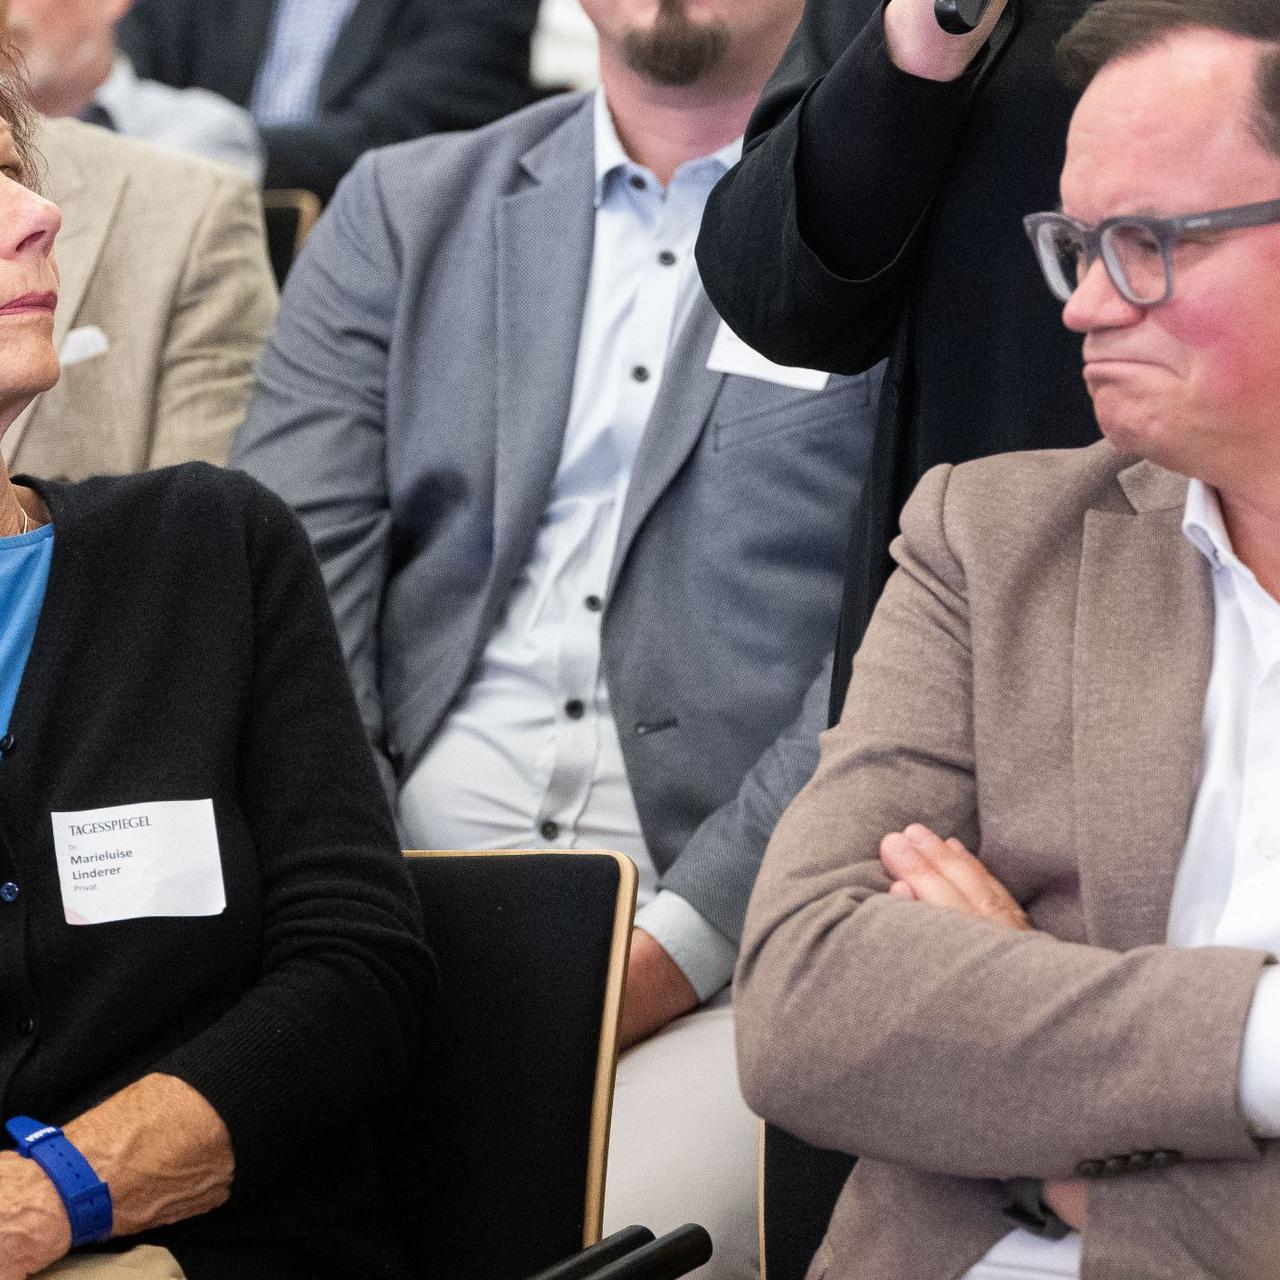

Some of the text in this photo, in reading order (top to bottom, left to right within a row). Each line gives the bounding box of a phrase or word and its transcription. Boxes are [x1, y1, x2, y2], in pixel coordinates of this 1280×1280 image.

[68, 815, 153, 837] TAGESSPIEGEL
[70, 849, 133, 865] Marieluise
[72, 866, 122, 880] Linderer
